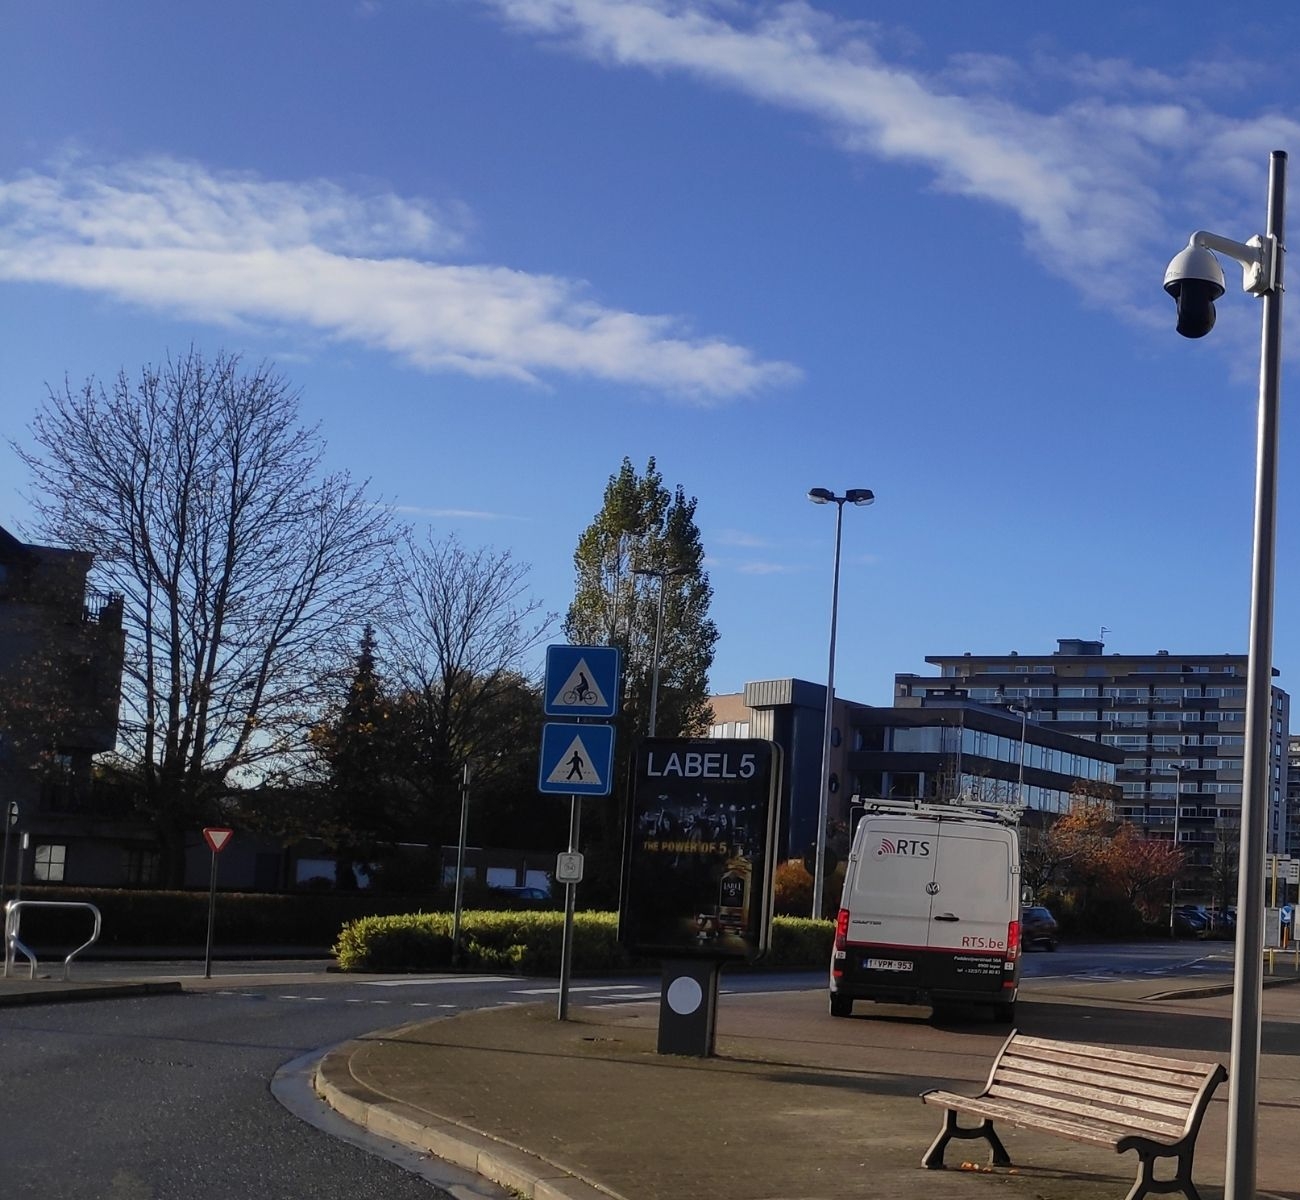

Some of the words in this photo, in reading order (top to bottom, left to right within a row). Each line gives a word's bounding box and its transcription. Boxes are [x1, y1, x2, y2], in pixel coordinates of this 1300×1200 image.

[643, 840, 659, 850] THE
[661, 841, 698, 852] POWER
[701, 842, 716, 853] OF
[719, 842, 728, 854] 5
[896, 839, 930, 856] RTS
[962, 936, 1004, 949] RTS.be
